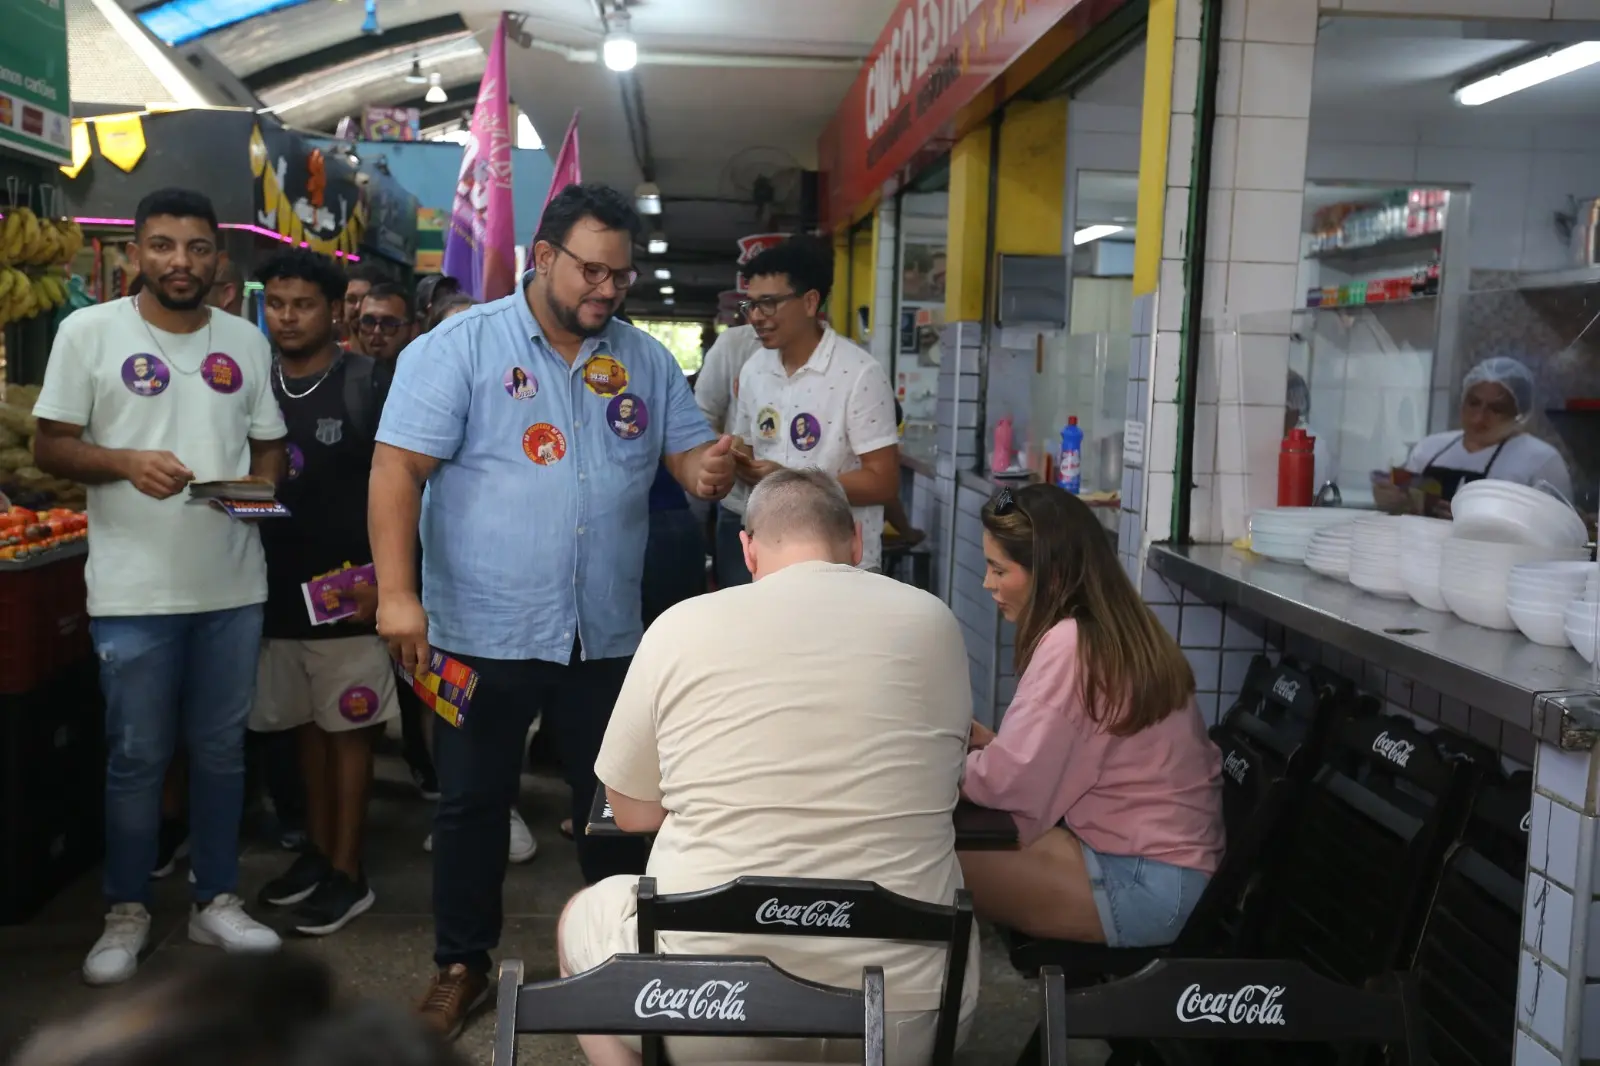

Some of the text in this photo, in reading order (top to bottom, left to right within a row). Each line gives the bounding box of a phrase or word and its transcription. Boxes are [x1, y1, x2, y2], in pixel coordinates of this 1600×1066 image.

[865, 6, 914, 140] CINCO
[1272, 674, 1300, 702] Coca-Cola
[1372, 731, 1416, 768] Coca-Cola
[755, 897, 855, 929] Coca-Cola
[635, 978, 750, 1021] Coca-Cola
[1176, 983, 1286, 1025] Coca-Cola
